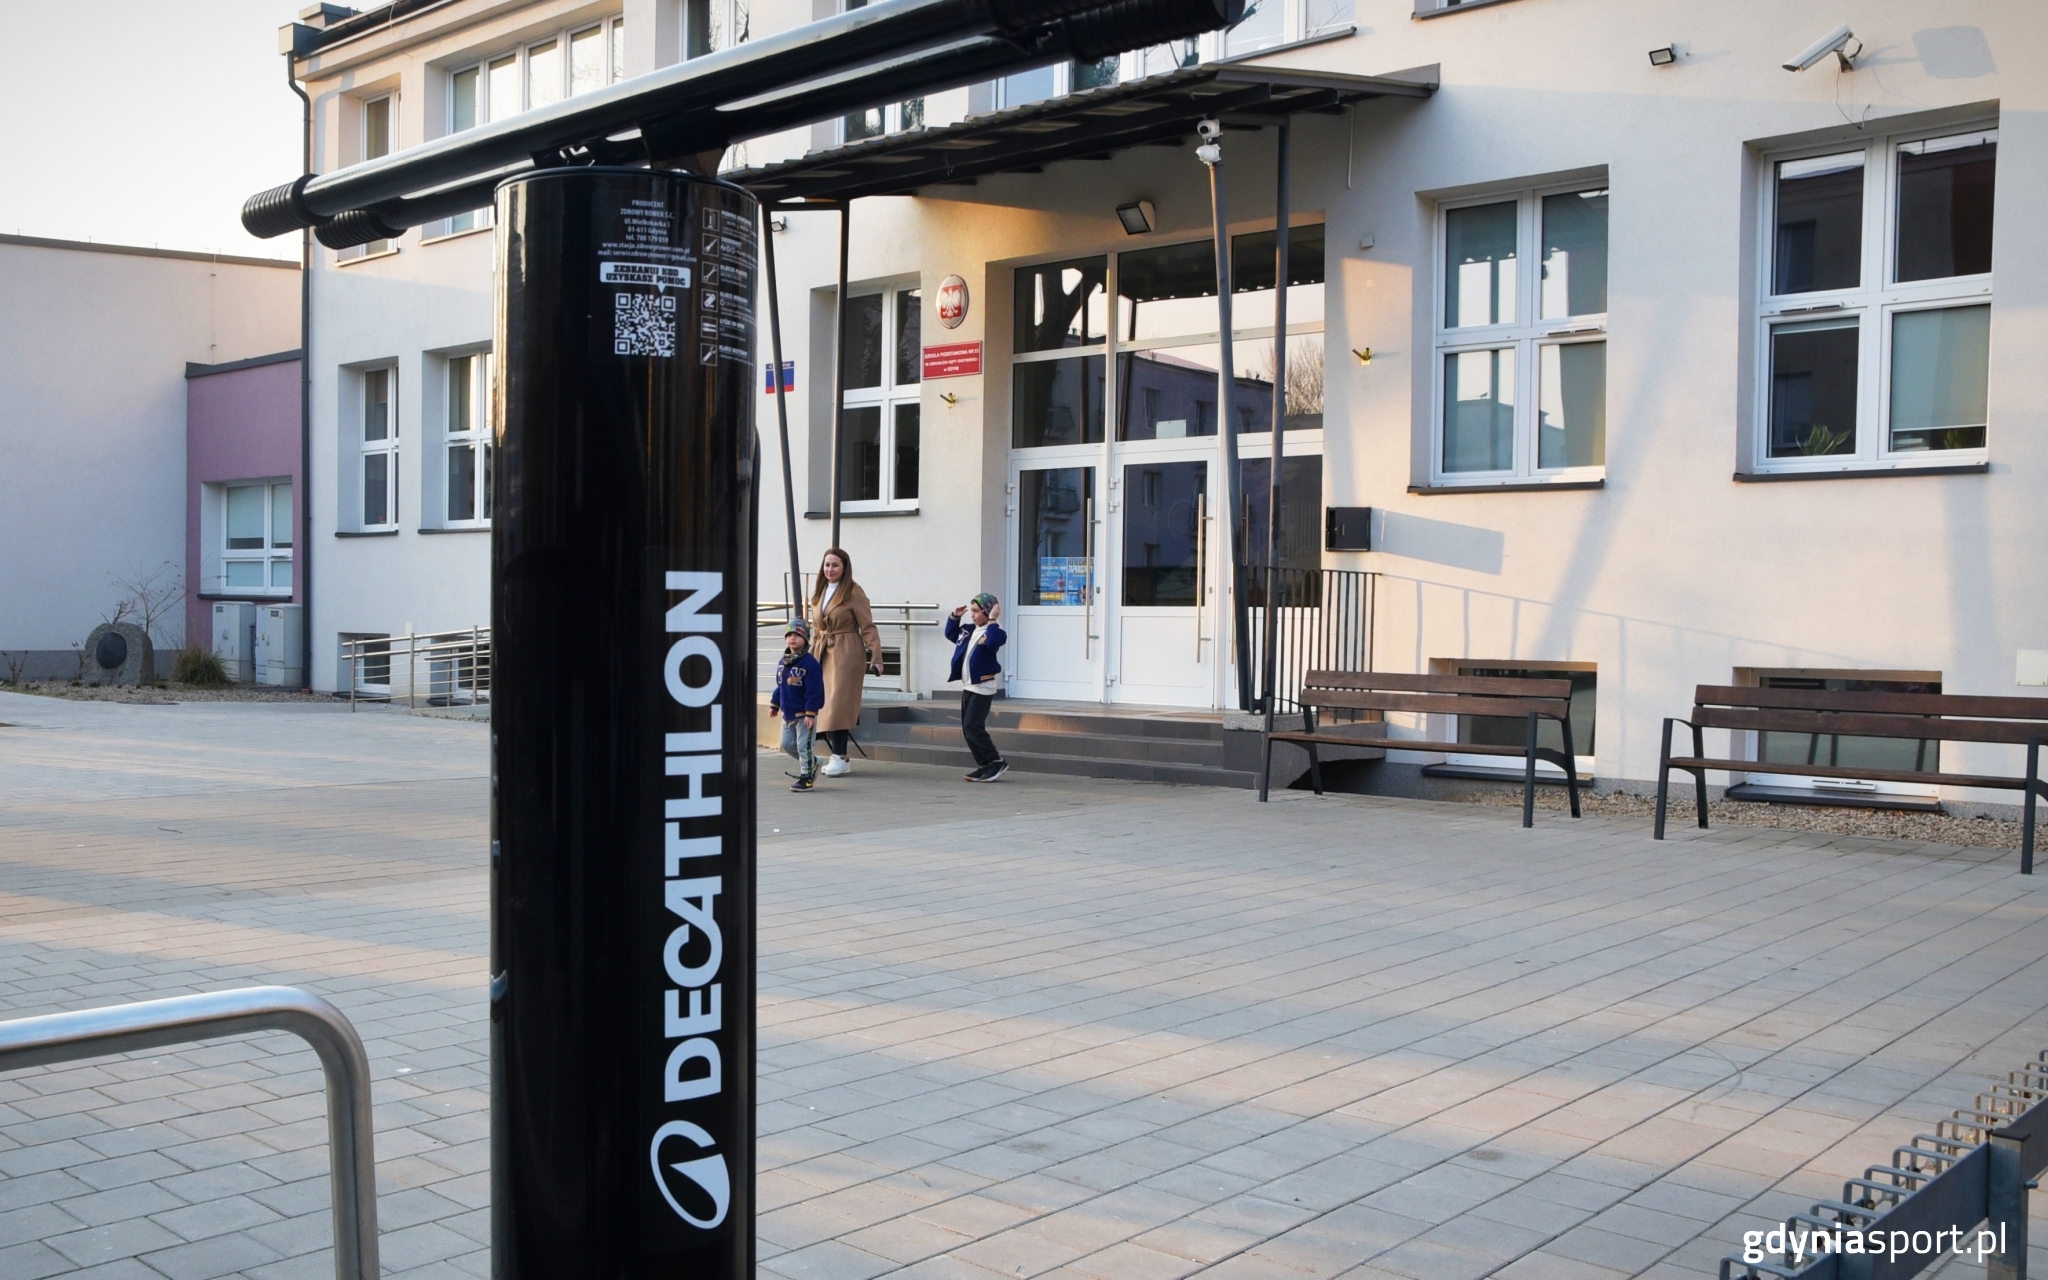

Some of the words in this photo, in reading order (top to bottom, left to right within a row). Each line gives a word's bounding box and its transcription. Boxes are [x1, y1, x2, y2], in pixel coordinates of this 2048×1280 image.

[632, 199, 664, 208] PRODUCENT
[620, 208, 643, 216] ZDROWY
[627, 226, 647, 234] 81-611
[647, 227, 667, 236] Gdynia
[613, 264, 659, 275] ZESKANUJ
[662, 268, 679, 277] KOD
[606, 273, 654, 282] UZYSKASZ
[656, 275, 686, 285] POMOC
[663, 570, 724, 1103] DECATHLON
